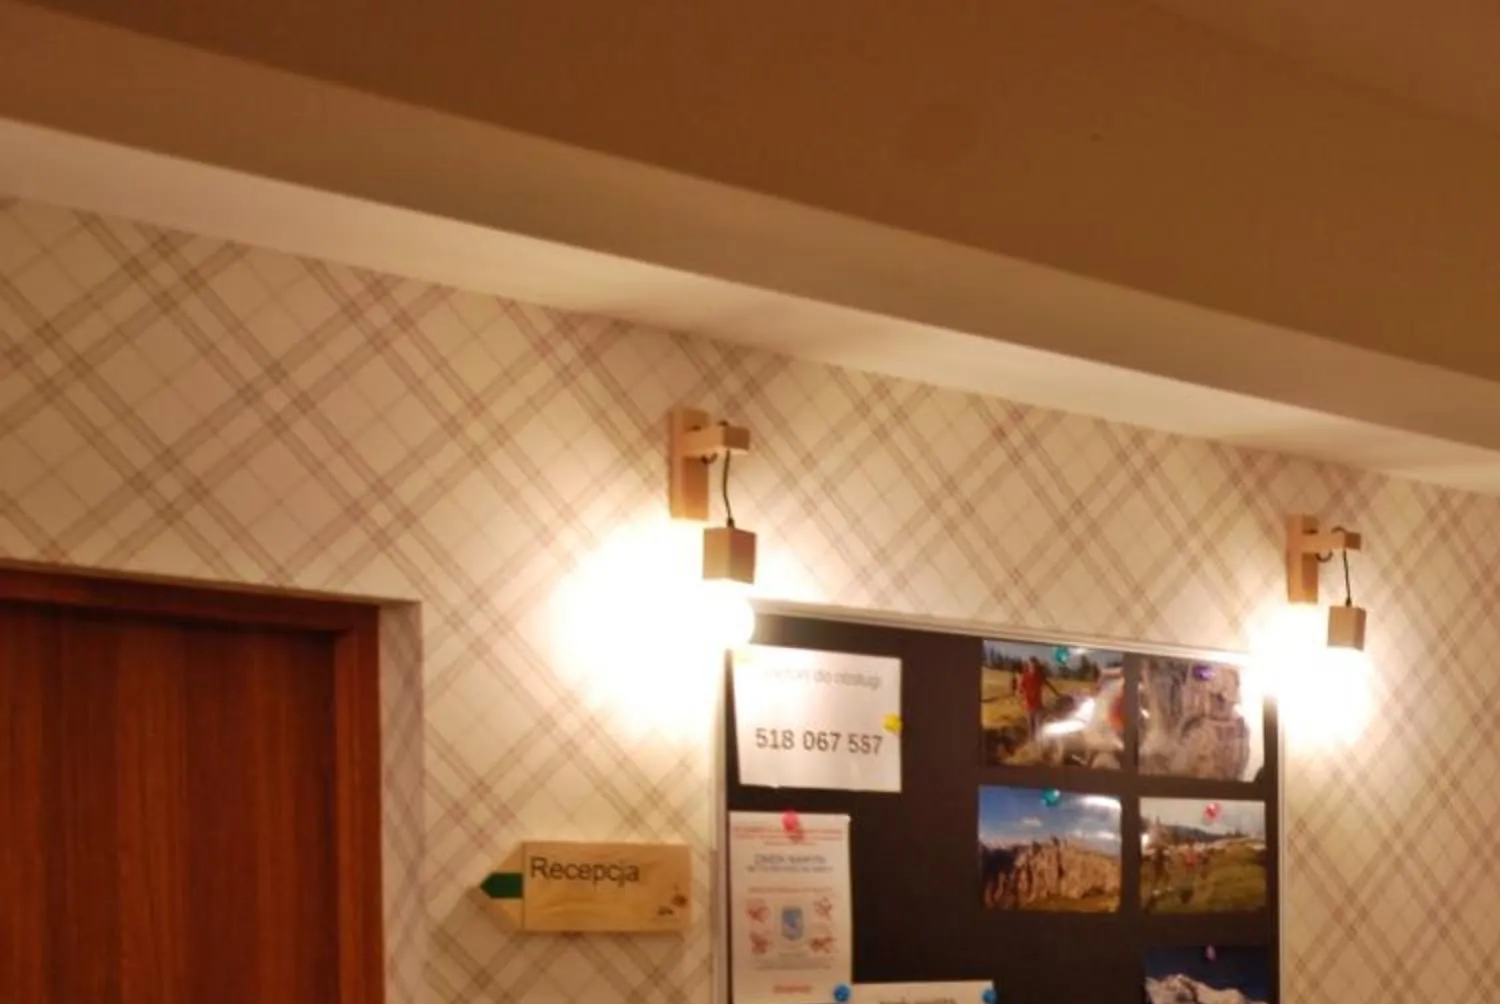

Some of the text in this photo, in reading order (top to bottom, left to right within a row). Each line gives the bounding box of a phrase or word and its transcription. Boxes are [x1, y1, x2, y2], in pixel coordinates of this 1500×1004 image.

[755, 727, 883, 755] 518 067 557
[530, 856, 640, 888] Recepcja
